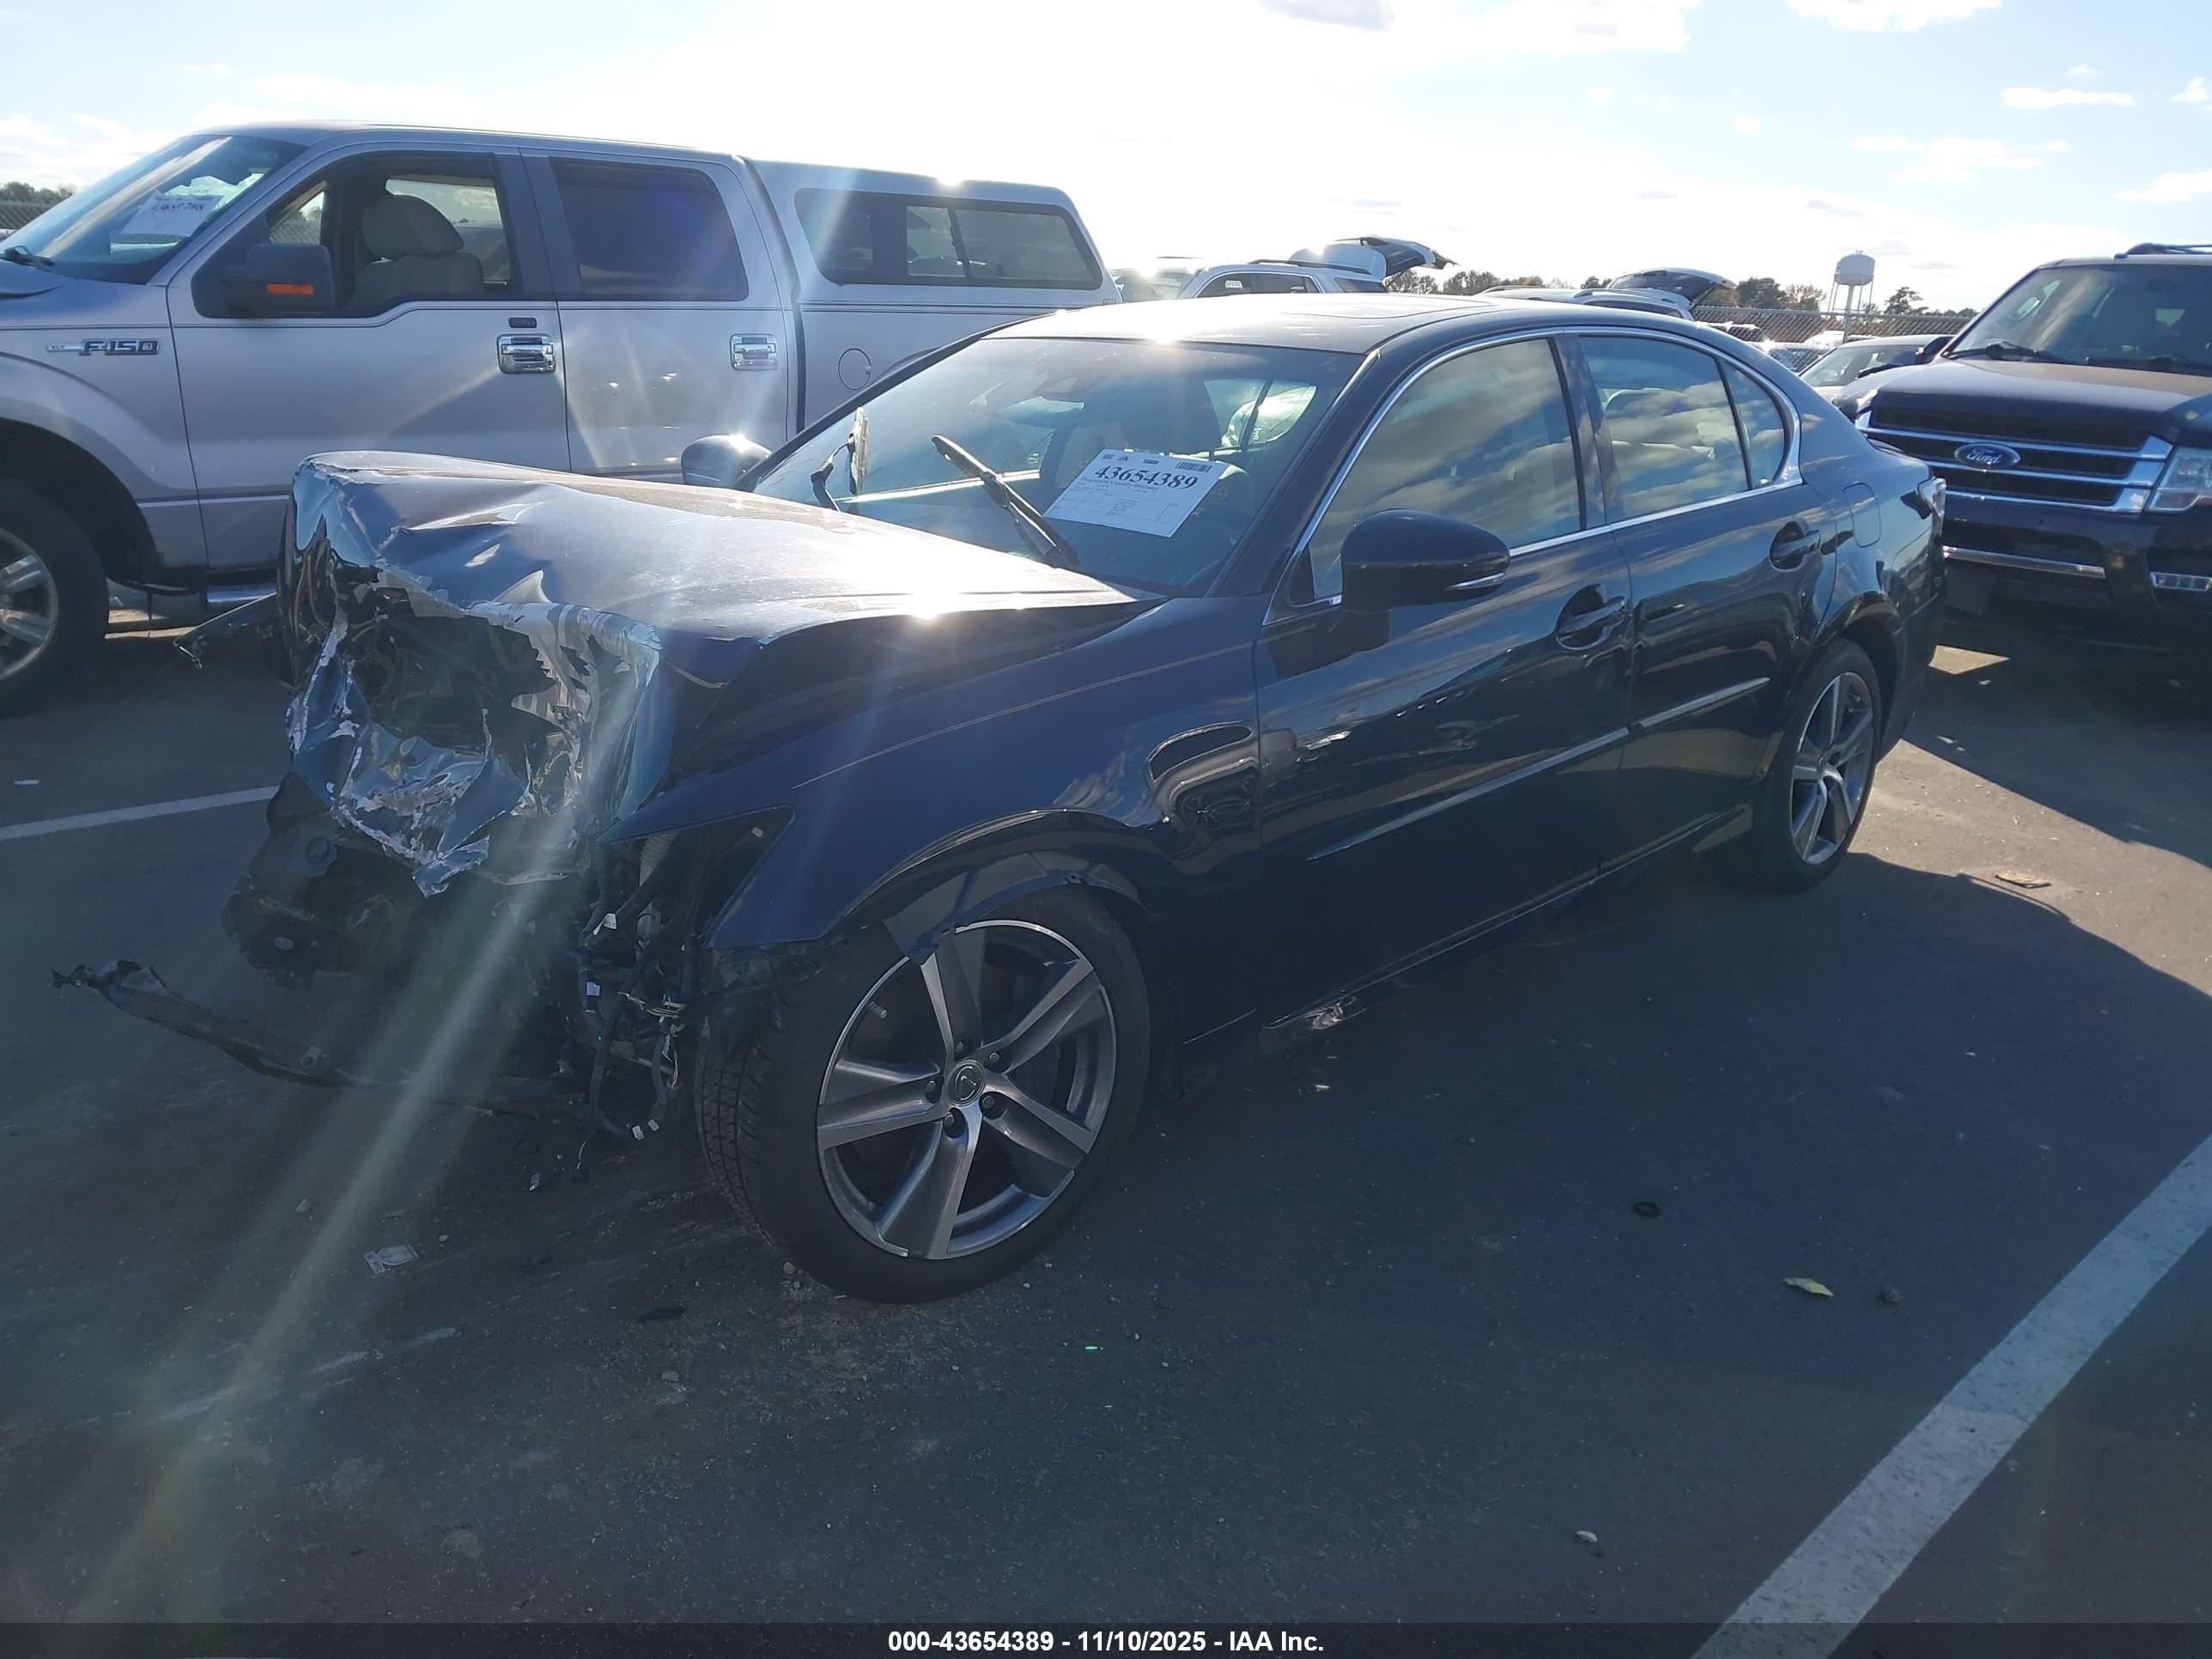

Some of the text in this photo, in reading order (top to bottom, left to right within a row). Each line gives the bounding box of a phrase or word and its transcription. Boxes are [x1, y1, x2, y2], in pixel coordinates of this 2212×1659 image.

[79, 338, 160, 356] F-150
[1966, 447, 2002, 465] Ford
[1094, 465, 1199, 489] 43654389
